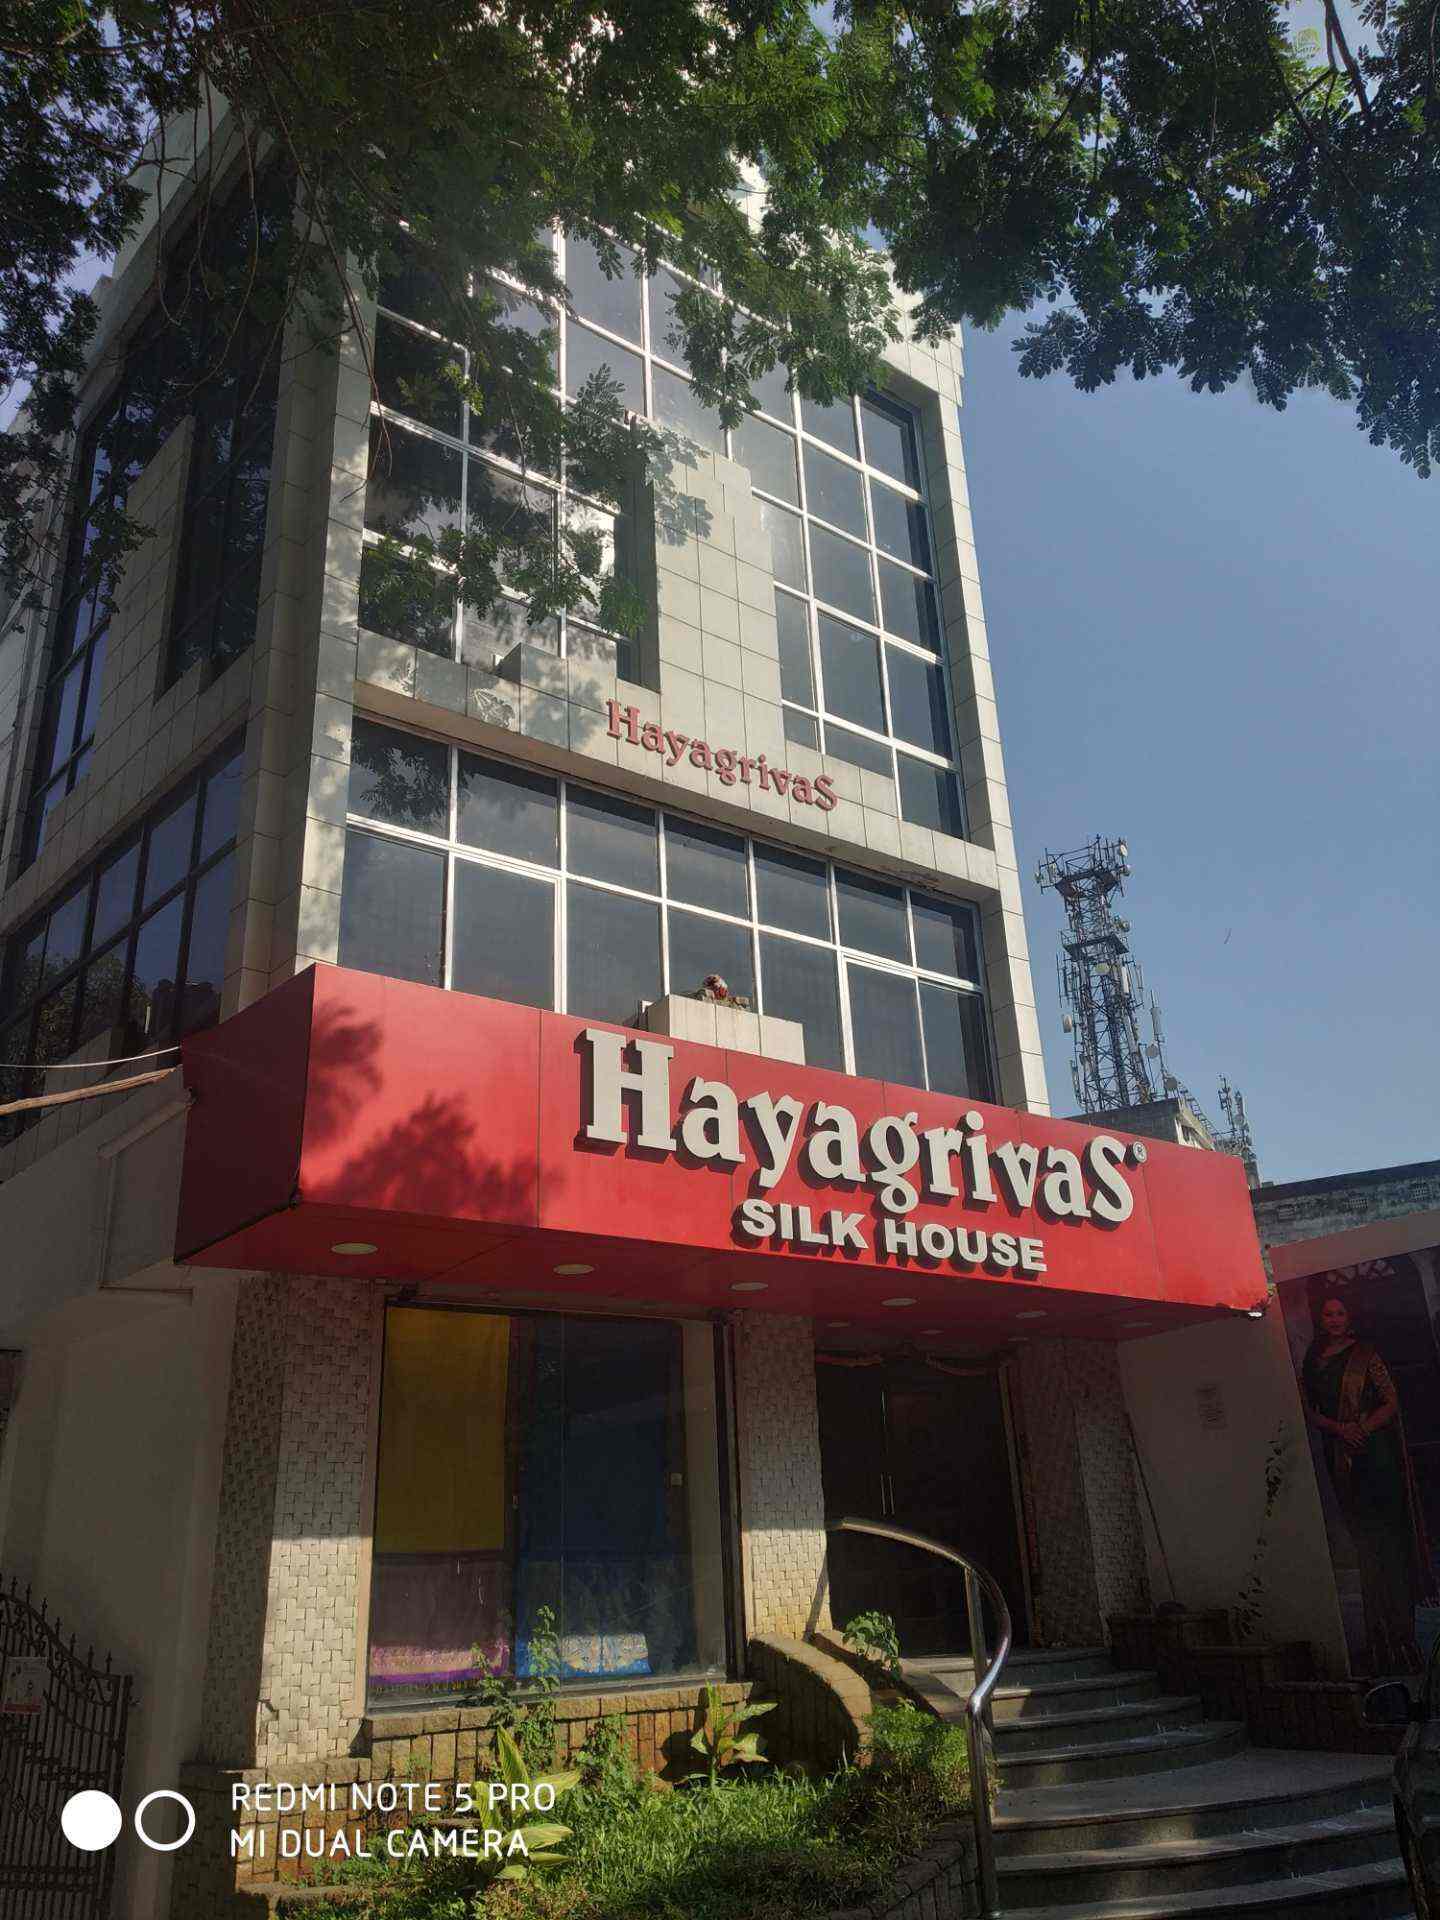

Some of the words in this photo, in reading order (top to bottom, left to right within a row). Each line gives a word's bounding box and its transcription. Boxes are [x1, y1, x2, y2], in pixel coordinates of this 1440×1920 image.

[606, 698, 838, 811] HayagrivaS
[741, 1198, 870, 1249] SILK
[885, 1217, 1048, 1272] HOUSE
